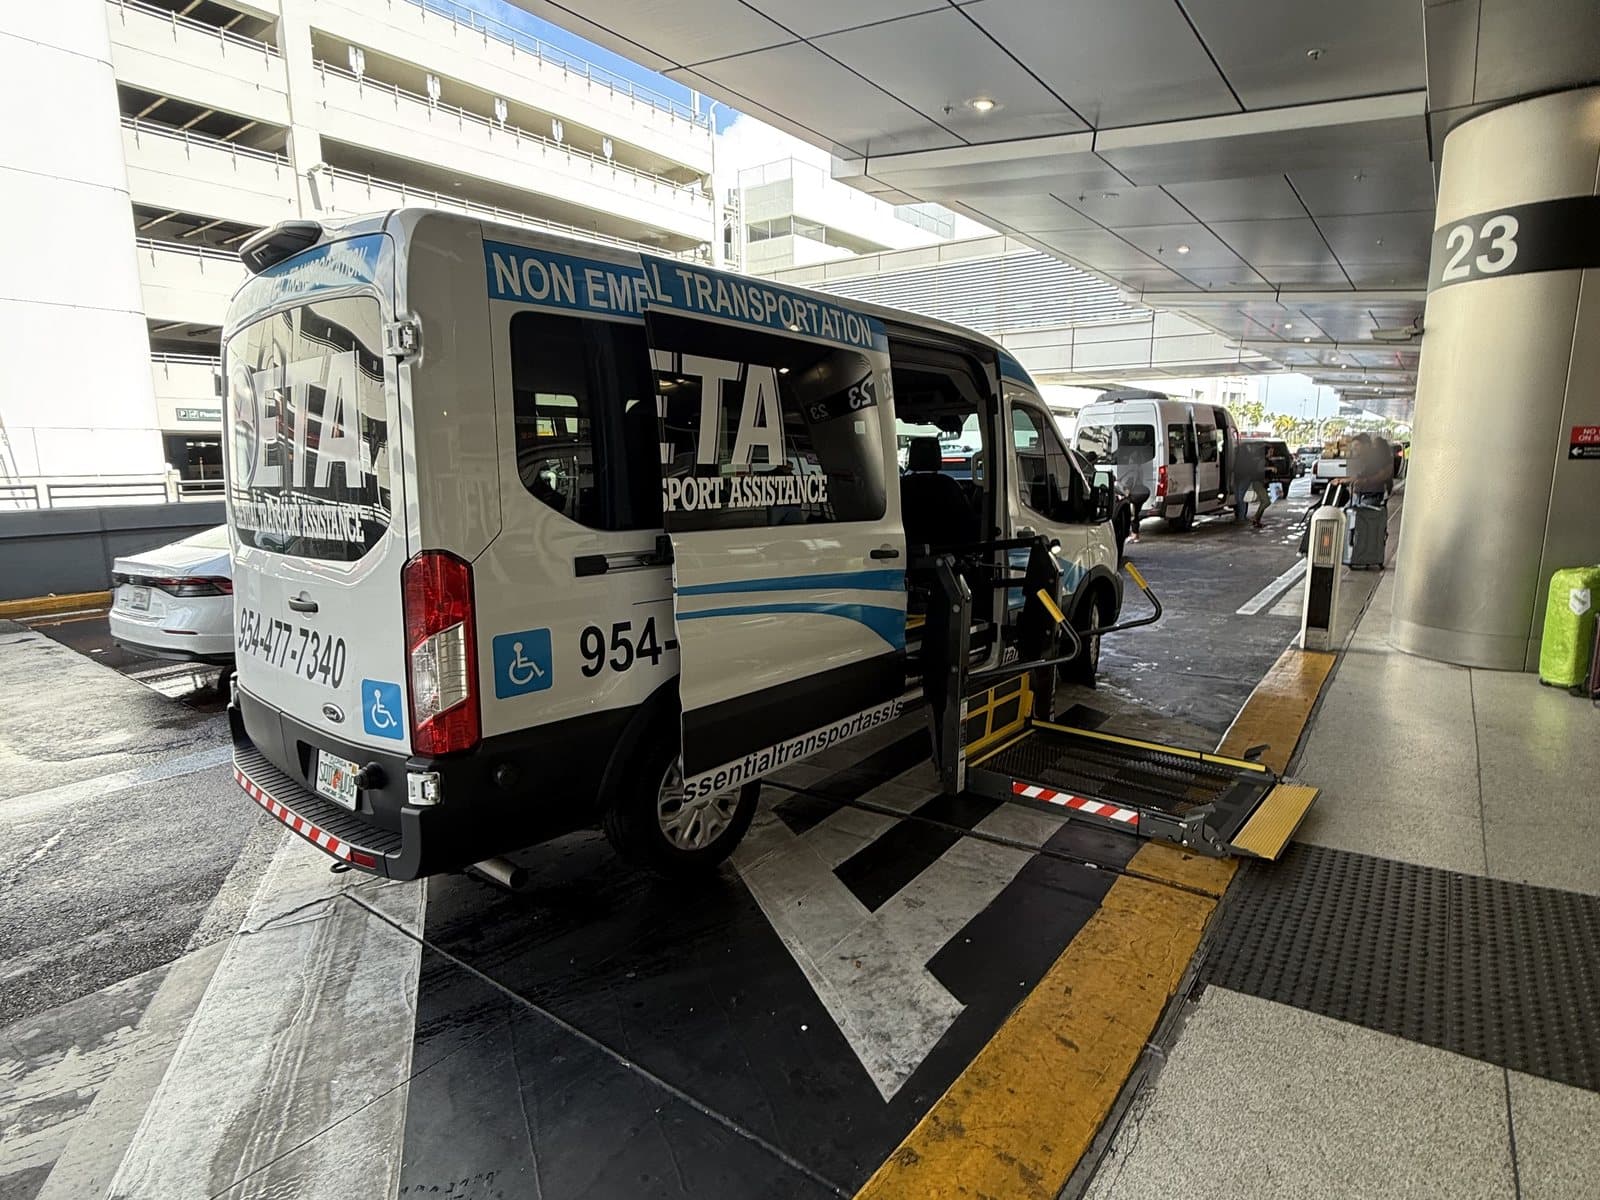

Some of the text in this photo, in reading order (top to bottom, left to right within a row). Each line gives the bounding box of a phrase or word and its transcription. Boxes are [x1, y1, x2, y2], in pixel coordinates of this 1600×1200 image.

[492, 252, 576, 304] NON
[1442, 214, 1519, 282] 23
[676, 269, 873, 347] TRANSPORTATION
[251, 350, 366, 488] ETA
[301, 504, 365, 543] ASSISTANCE
[728, 475, 828, 508] ASSISTANCE
[239, 607, 346, 689] 954-477-7340
